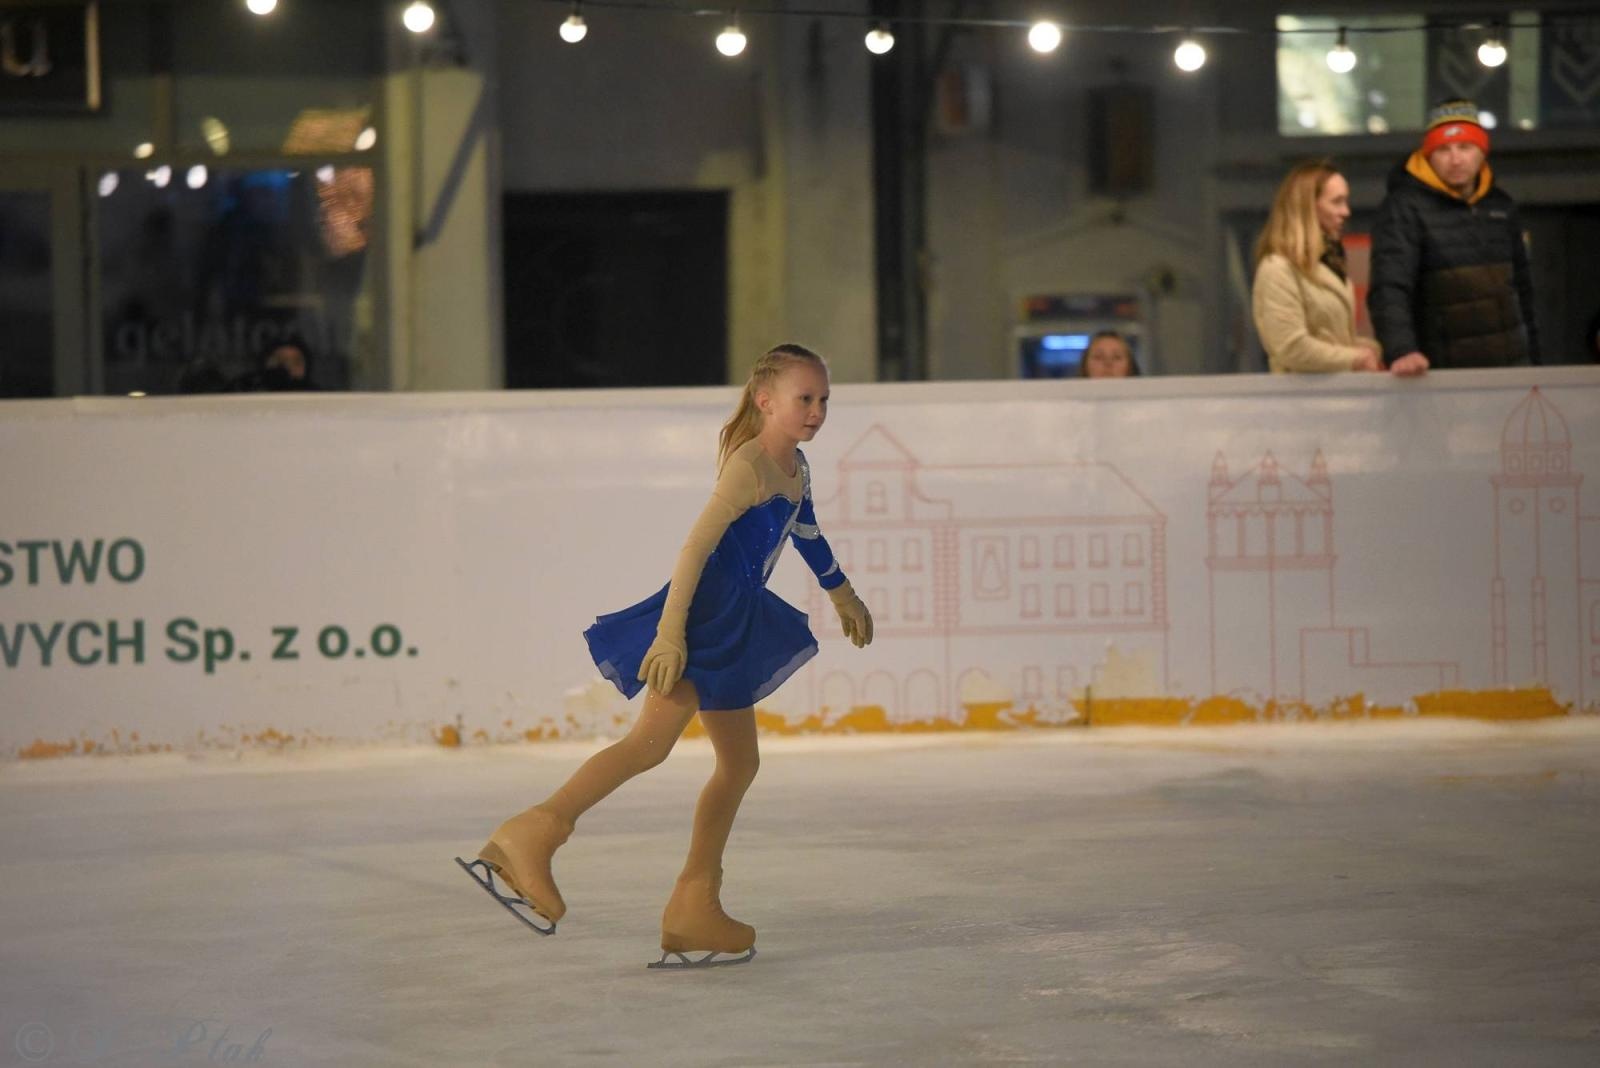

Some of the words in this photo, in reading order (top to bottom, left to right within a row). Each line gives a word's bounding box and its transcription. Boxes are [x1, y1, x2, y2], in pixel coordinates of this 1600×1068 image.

[165, 618, 250, 674] Sp.
[272, 627, 299, 660] z
[318, 625, 418, 659] o.o.
